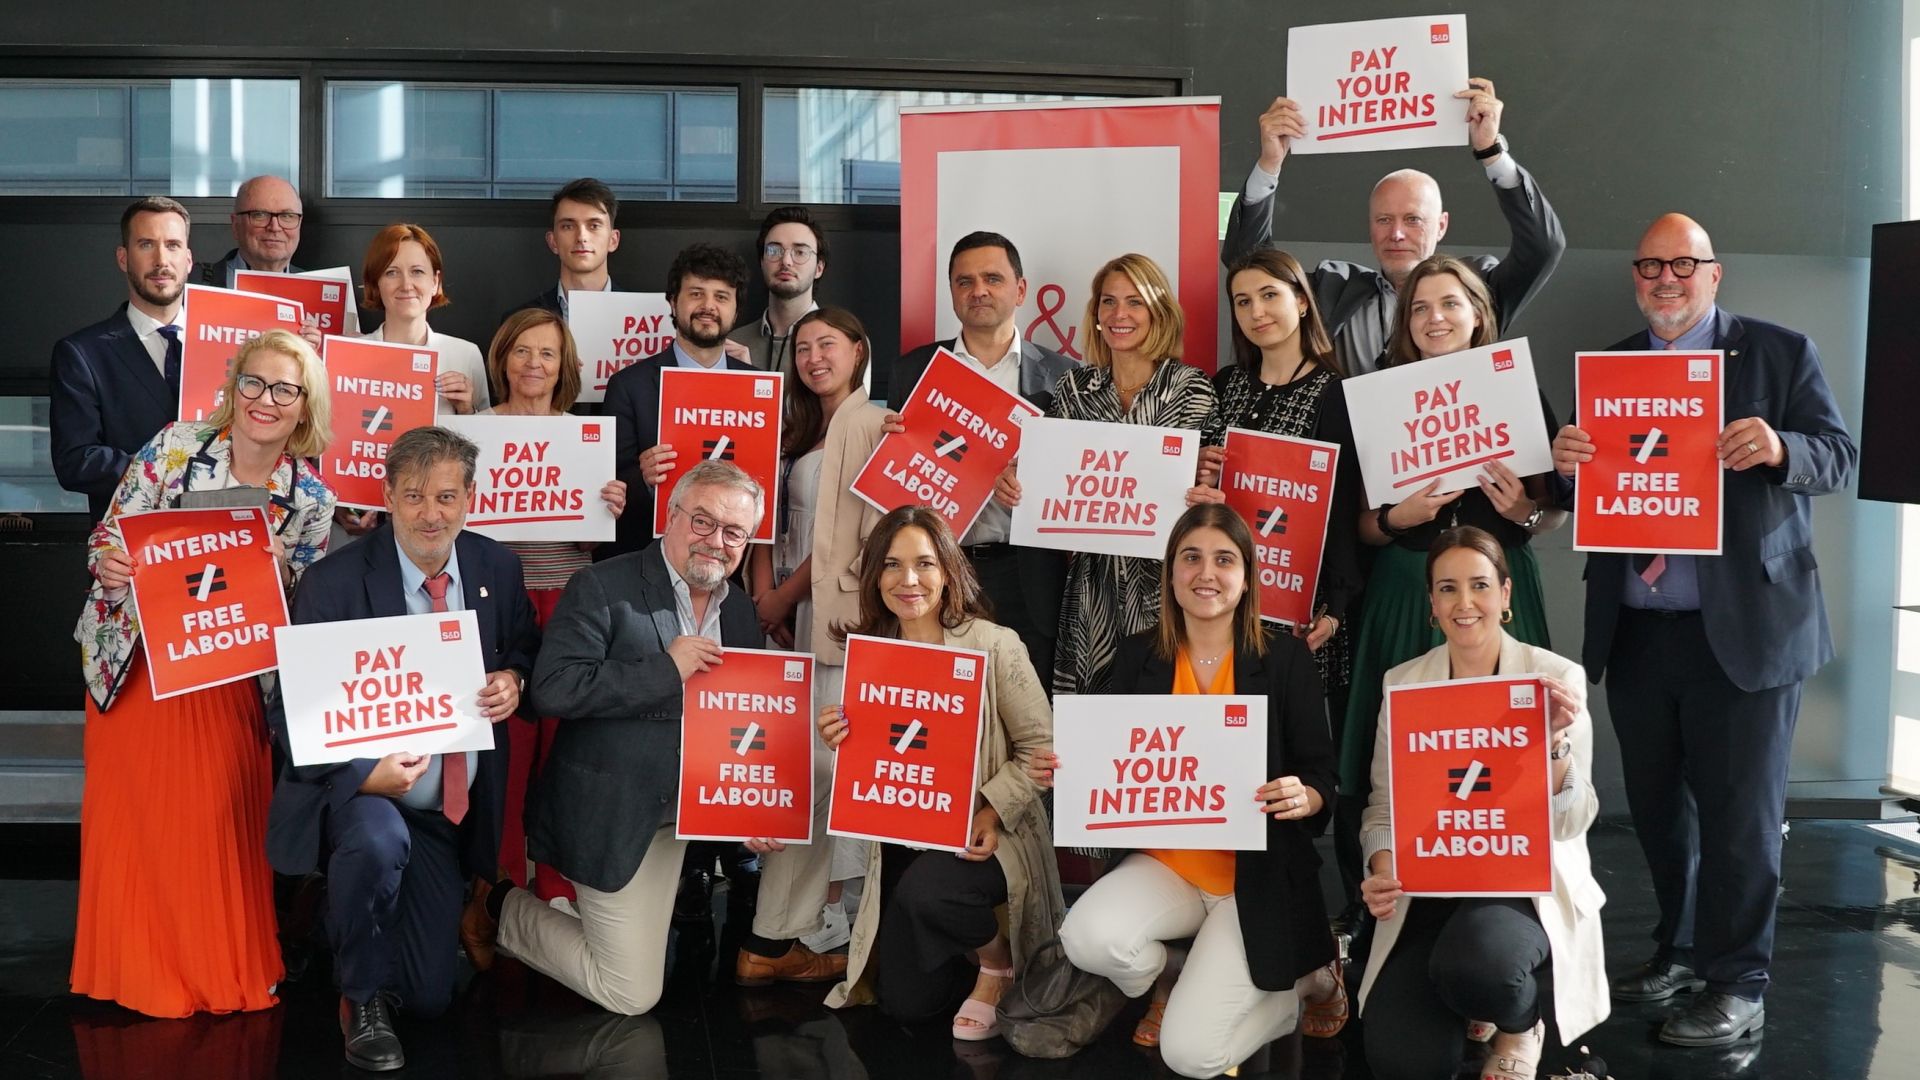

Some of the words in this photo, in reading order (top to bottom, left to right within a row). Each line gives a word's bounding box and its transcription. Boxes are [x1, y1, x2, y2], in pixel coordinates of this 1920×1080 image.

[1431, 34, 1449, 42] S&D
[1350, 46, 1398, 73] PAY
[1337, 71, 1410, 99] YOUR
[1318, 94, 1436, 127] INTERNS
[199, 324, 264, 346] INTER
[624, 315, 664, 334] PAY
[1494, 358, 1513, 370] S&D
[1690, 369, 1710, 380] S&D
[336, 375, 423, 401] INTERNS
[1414, 380, 1461, 412] PAY
[674, 407, 766, 428] INTERNS
[926, 388, 1009, 450] INTERNS
[1594, 397, 1704, 418] INTERNS
[1403, 404, 1481, 441] YOUR
[351, 440, 393, 459] FRE
[583, 433, 600, 441] S&D
[1163, 445, 1181, 454] S&D
[1391, 422, 1510, 475] INTERNS
[503, 441, 550, 463] PAY
[1080, 449, 1129, 471] PAY
[1311, 460, 1326, 469] S&D
[335, 459, 387, 480] LABO
[489, 466, 561, 489] YOUR
[908, 452, 959, 493] FREE
[1617, 472, 1680, 492] FREE
[882, 459, 960, 520] LABOUR
[1064, 473, 1138, 499] YOUR
[1233, 471, 1319, 503] INTERNS
[1040, 498, 1158, 526] INTERNS
[1595, 495, 1700, 517] LABOUR
[144, 529, 253, 565] INTERNS
[1255, 544, 1292, 568] REE
[1258, 569, 1304, 593] OUR
[182, 603, 246, 634] FREE
[167, 623, 270, 662] LABOUR
[441, 630, 461, 640] S&D
[355, 645, 406, 674] PAY
[784, 671, 803, 680] S&D
[955, 669, 974, 678] S&D
[342, 672, 423, 704] YOUR
[859, 682, 964, 714] INTERNS
[698, 690, 796, 715] INTERNS
[1512, 695, 1534, 707] S&D
[324, 694, 454, 735] INTERNS
[1226, 716, 1246, 725] S&D
[1128, 726, 1185, 754] PAY
[1408, 726, 1529, 752] INTERNS
[718, 763, 776, 784] FREE
[874, 759, 935, 787] FREE
[1113, 756, 1199, 783] YOUR
[698, 784, 795, 809] LABOUR
[852, 780, 952, 813] LABOUR
[1089, 784, 1227, 815] INTERNS
[1436, 809, 1505, 831] FREE
[1415, 834, 1530, 858] LABOUR
